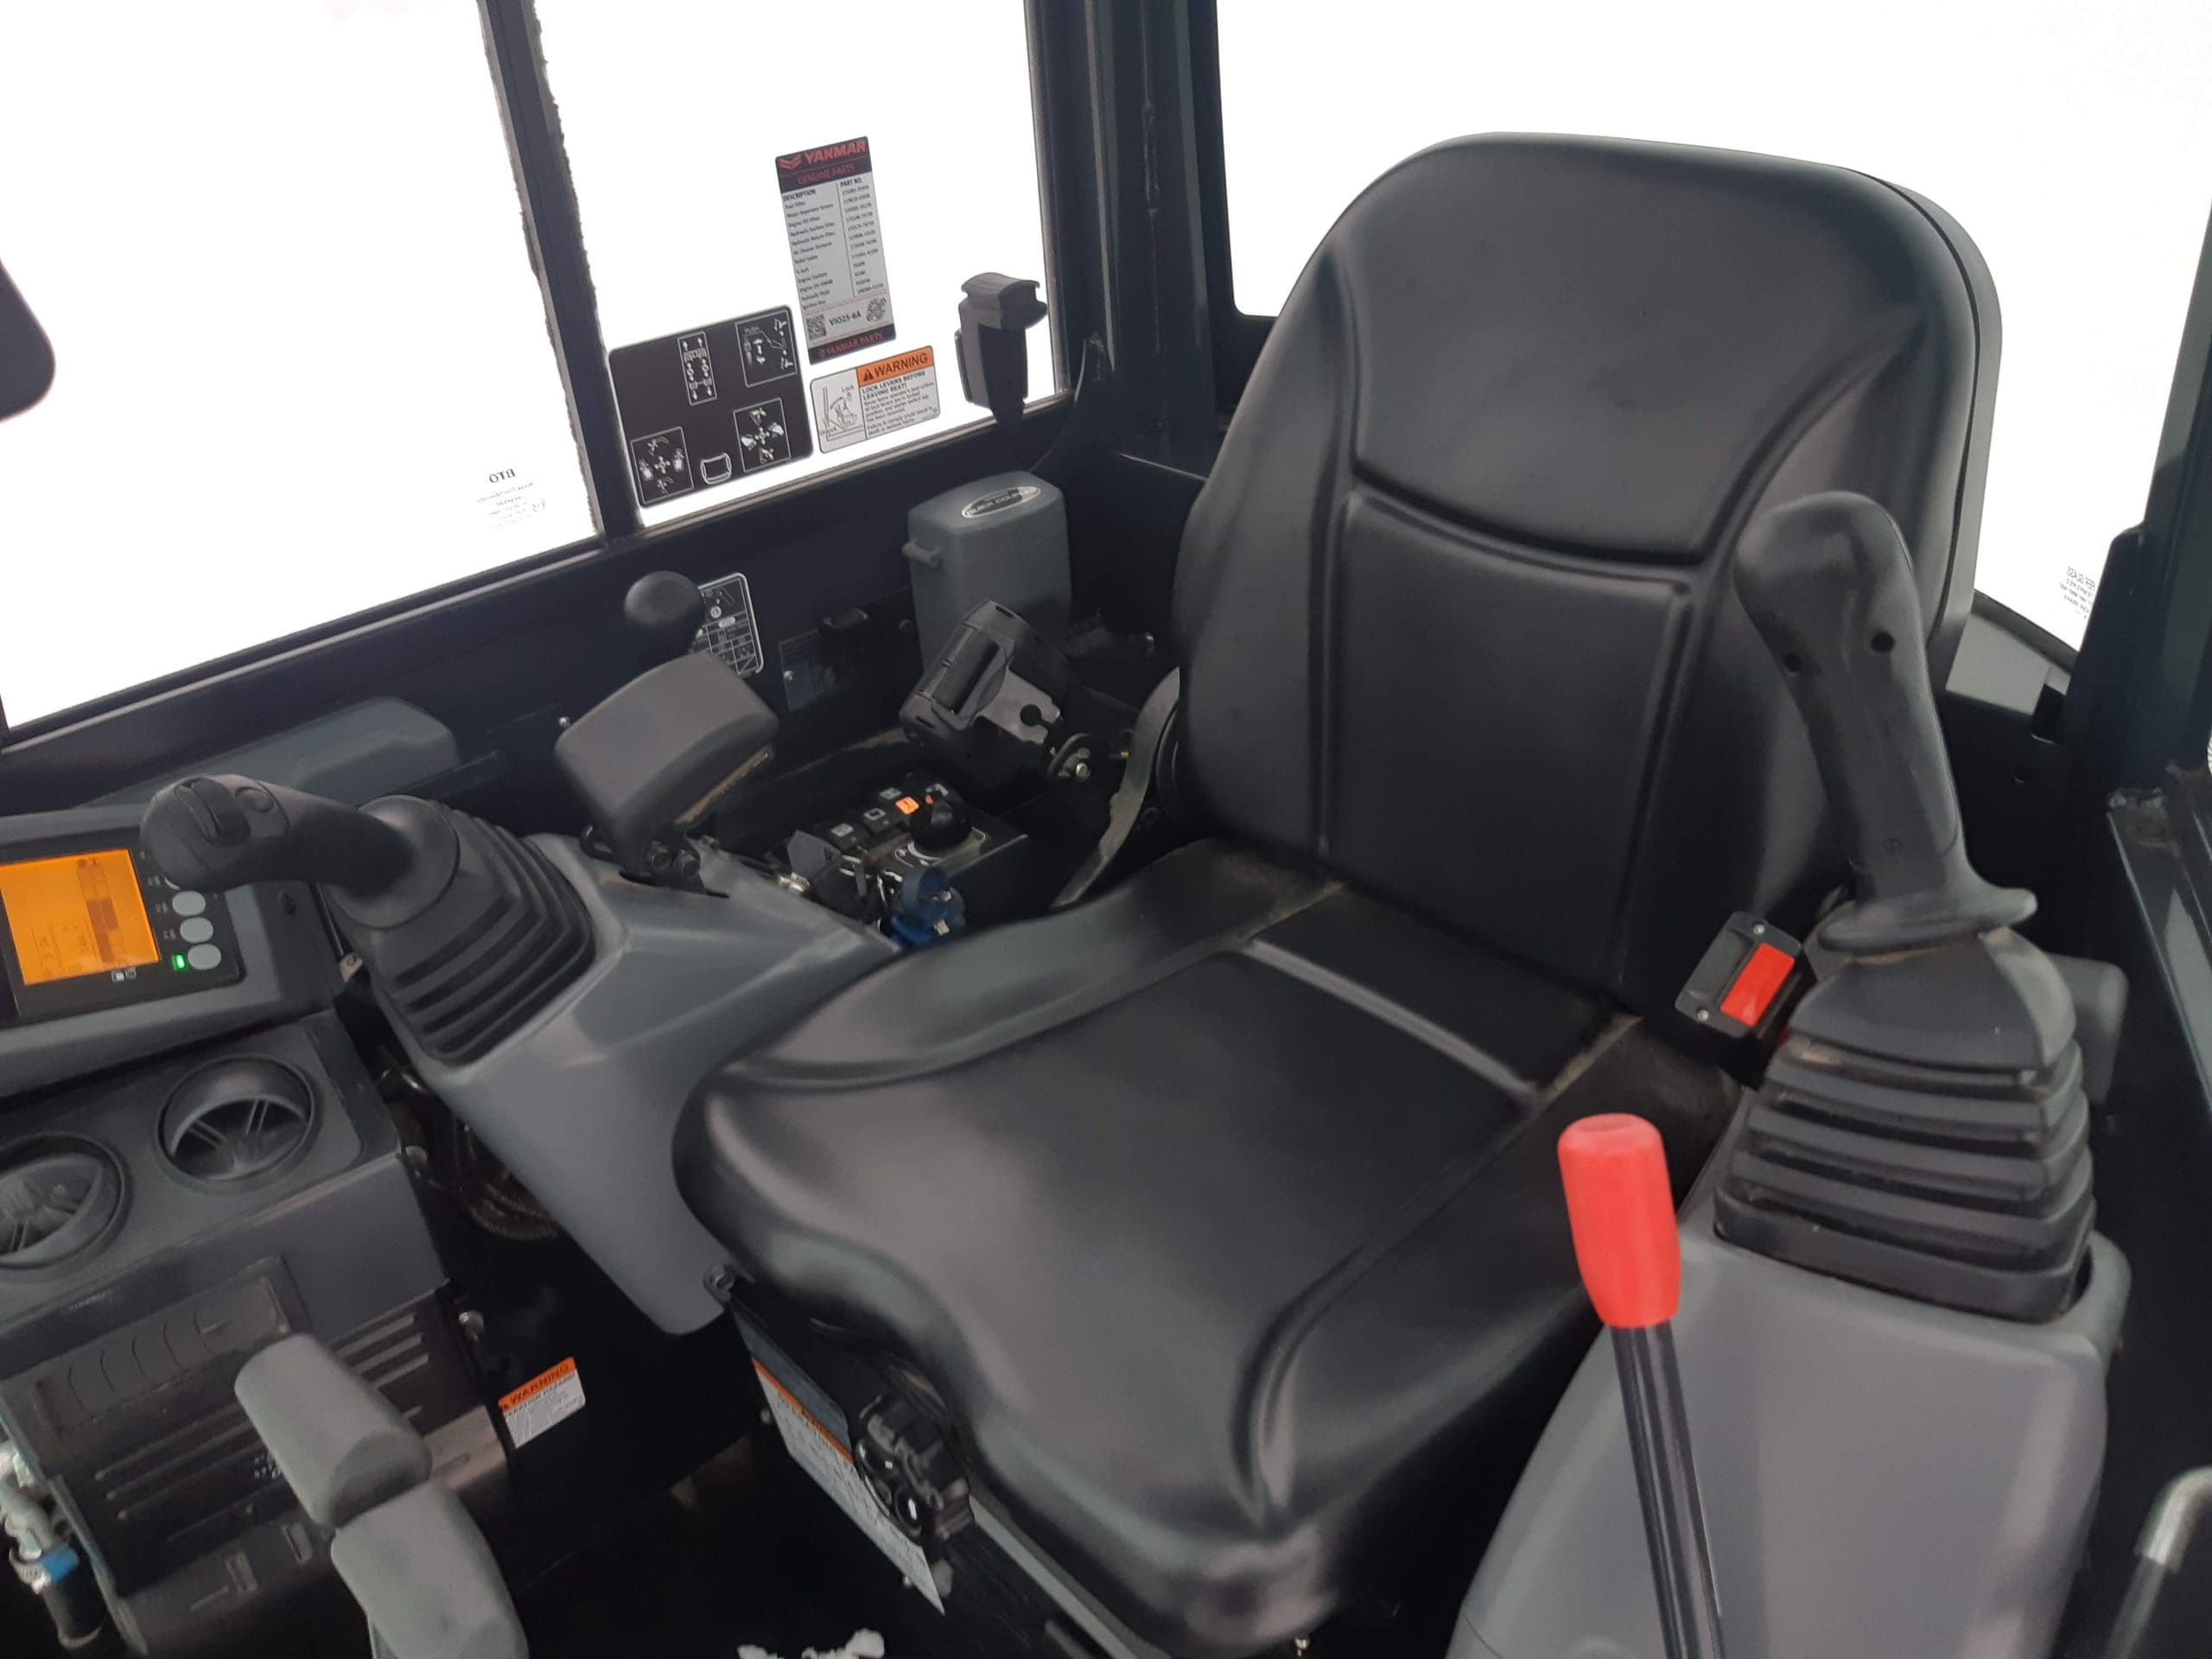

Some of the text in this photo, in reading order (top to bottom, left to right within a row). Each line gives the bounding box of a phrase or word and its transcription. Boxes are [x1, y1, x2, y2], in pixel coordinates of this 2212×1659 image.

[804, 139, 866, 165] YANMAR
[797, 163, 855, 185] GENUINE PARTS
[783, 188, 816, 201] DESCRIPTION
[874, 352, 927, 377] WARNING
[862, 371, 925, 393] LOCK LEVERS BEFORE
[863, 388, 887, 400] LEAVING
